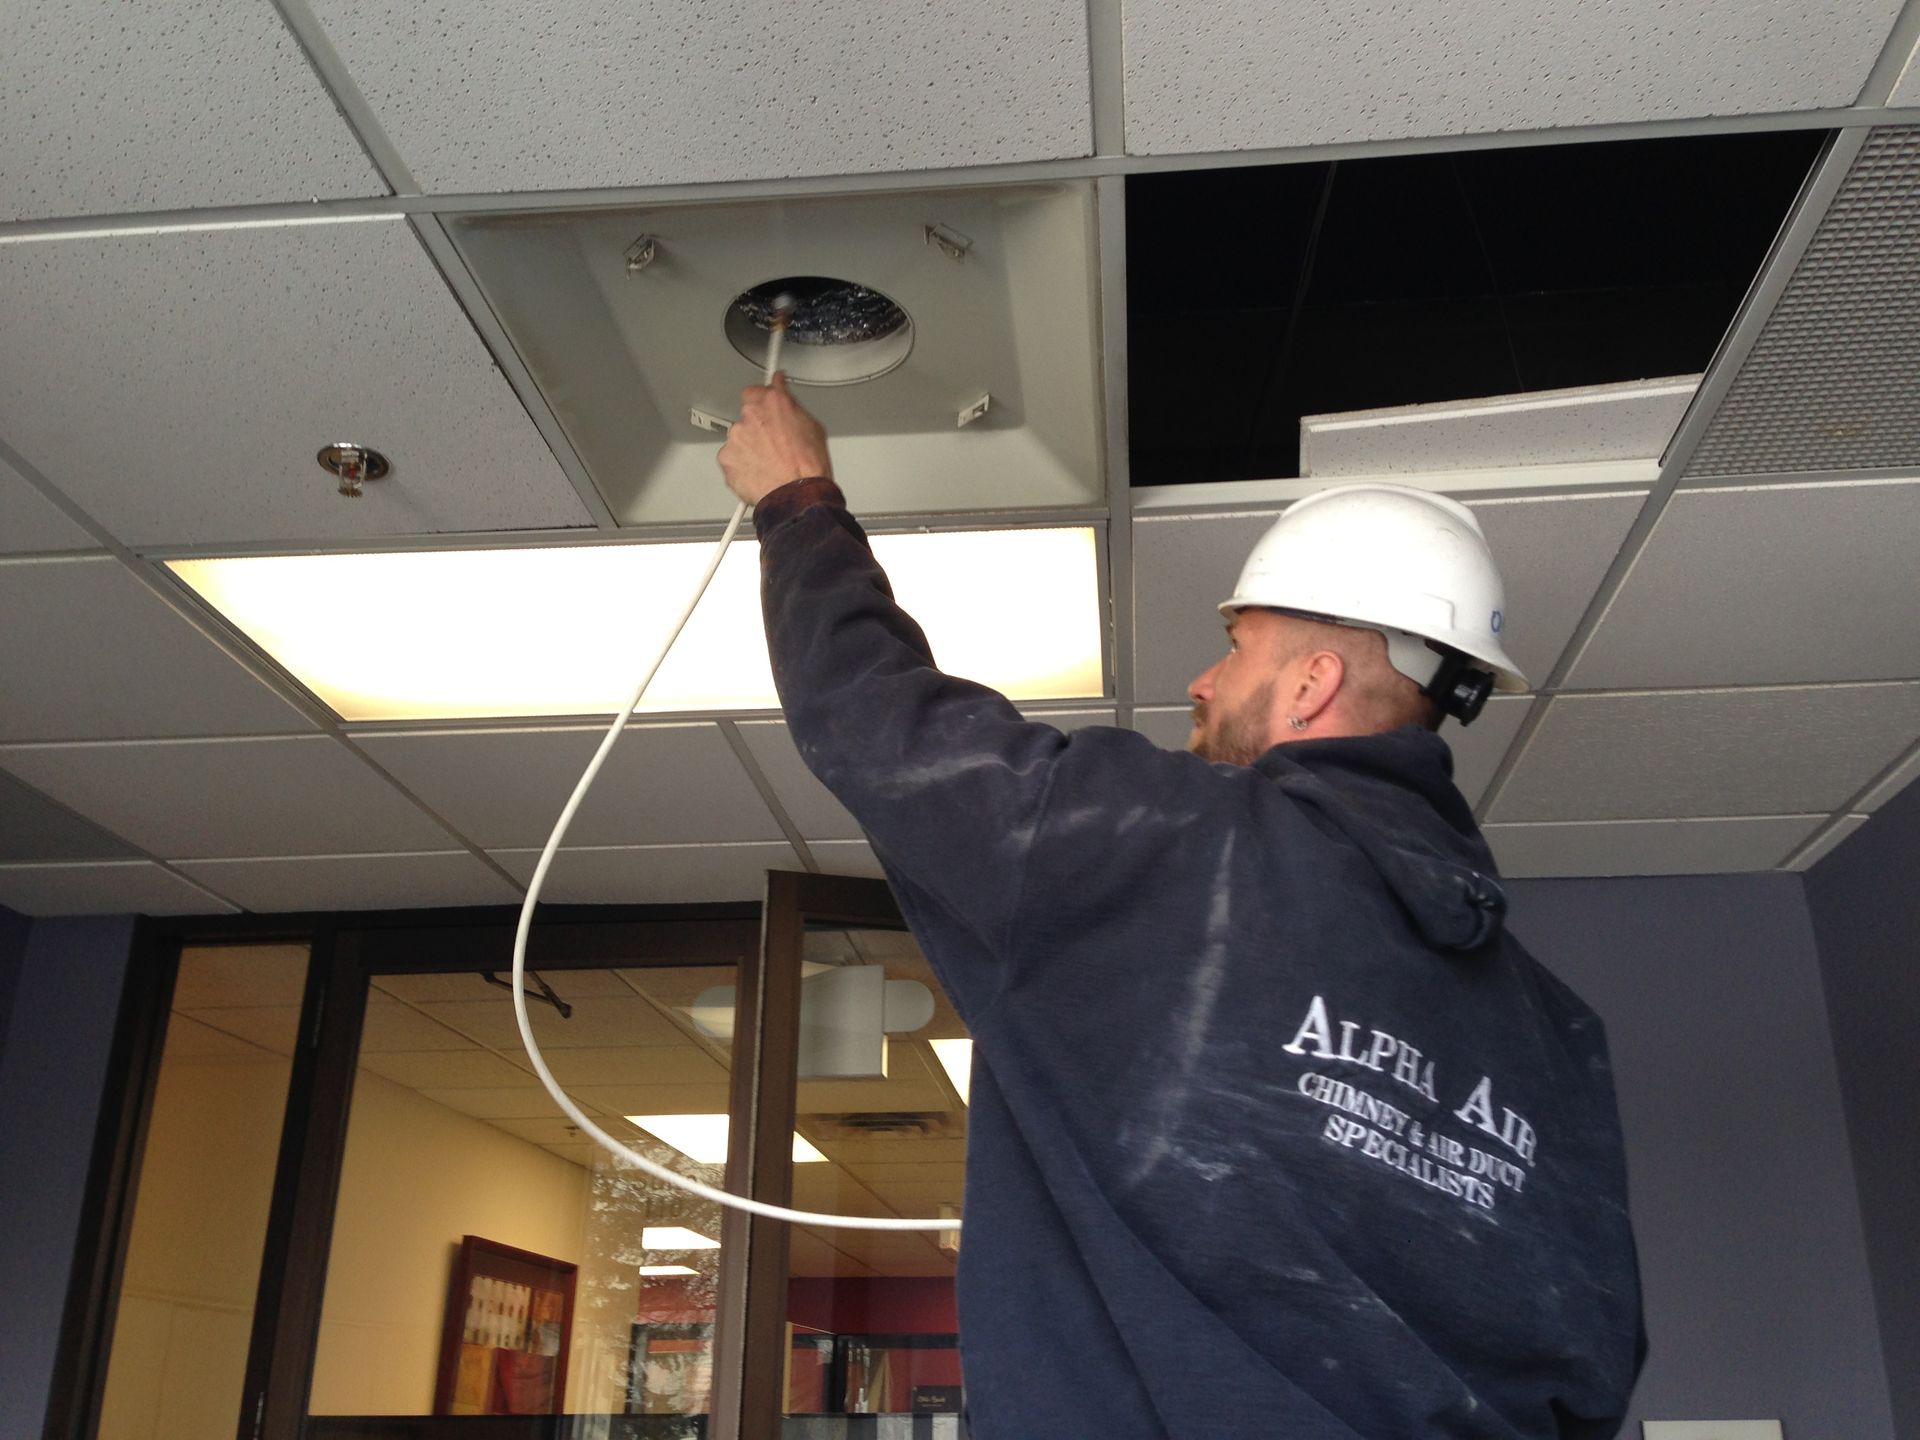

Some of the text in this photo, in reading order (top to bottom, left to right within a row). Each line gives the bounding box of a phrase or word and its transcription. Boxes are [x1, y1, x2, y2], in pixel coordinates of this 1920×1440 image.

[1282, 995, 1537, 1167] ALPHA AIR
[1298, 1072, 1526, 1192] CHIMNEY & AIR DUCT
[1324, 1114, 1495, 1209] SPECIALISTS
